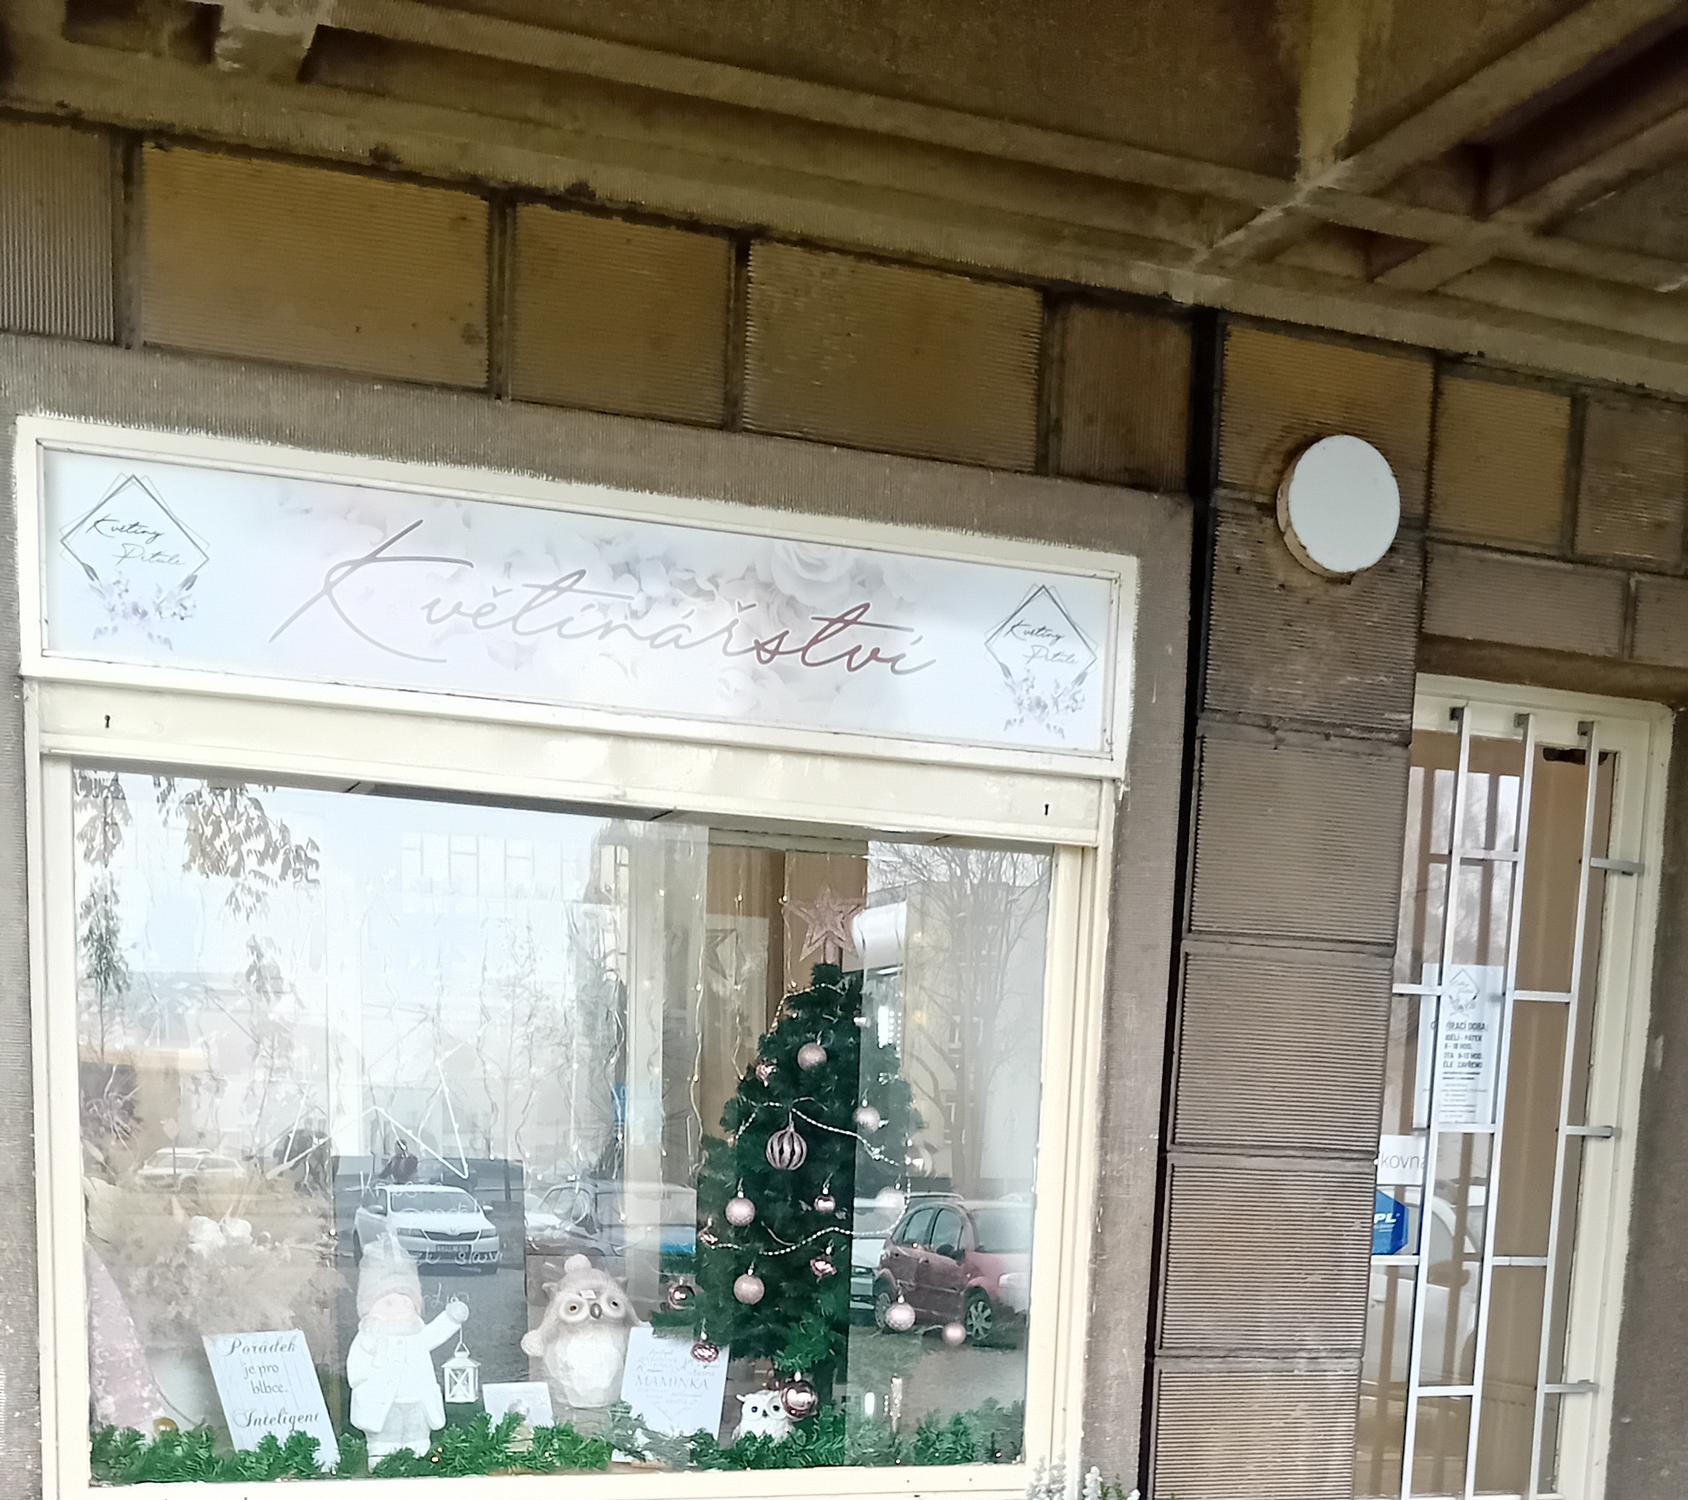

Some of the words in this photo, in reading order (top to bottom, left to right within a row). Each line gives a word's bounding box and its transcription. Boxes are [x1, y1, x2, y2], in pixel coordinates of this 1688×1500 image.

[269, 519, 936, 677] Květinářství
[258, 1363, 279, 1378] pro
[233, 1407, 319, 1431] Inteligent
